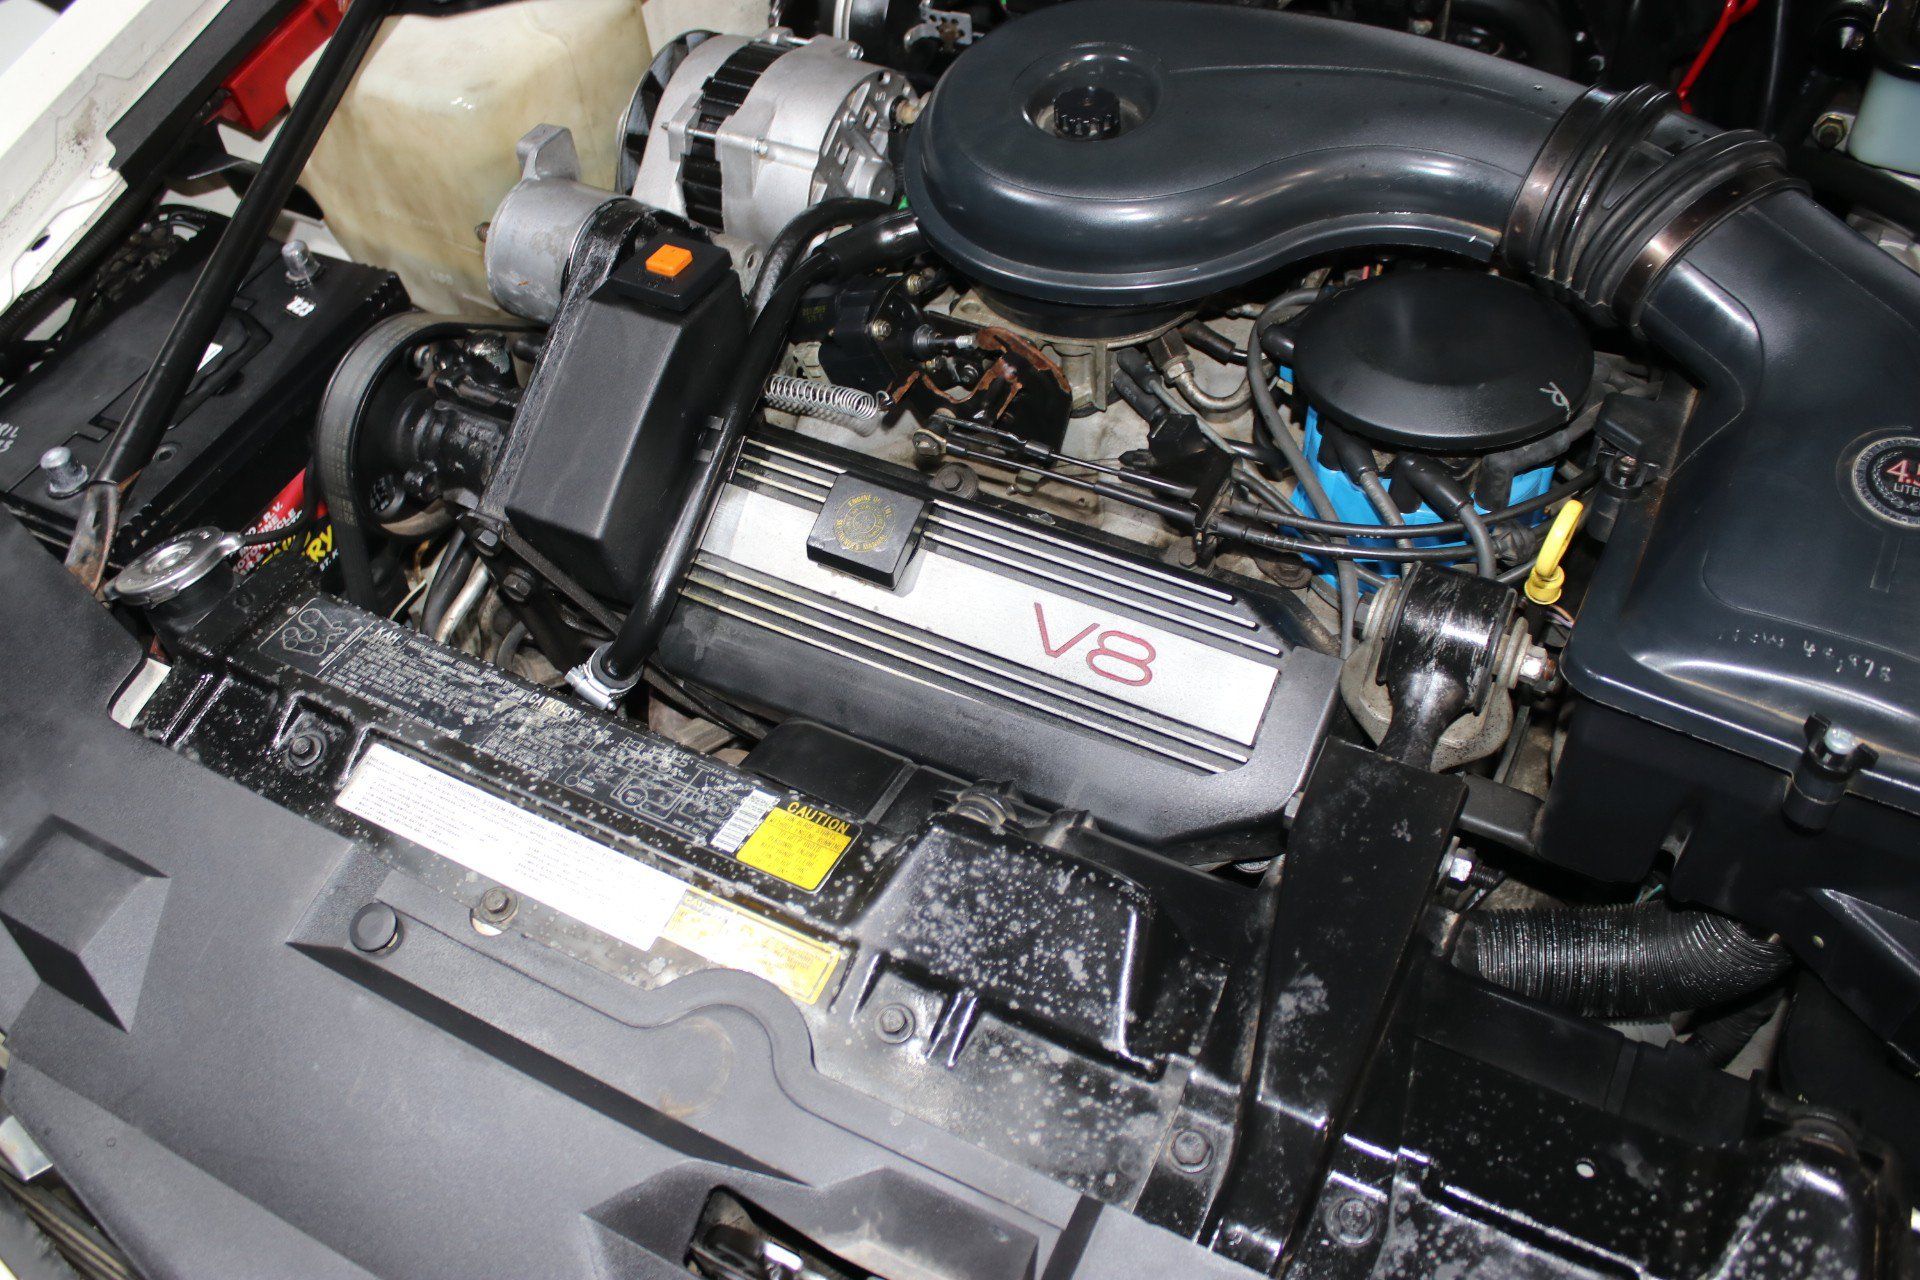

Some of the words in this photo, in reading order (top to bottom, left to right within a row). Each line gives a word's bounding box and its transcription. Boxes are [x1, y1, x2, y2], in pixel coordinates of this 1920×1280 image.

[373, 626, 402, 643] KAH
[1034, 602, 1156, 686] V8
[528, 692, 580, 720] CATALYST
[787, 801, 850, 834] CAUTION
